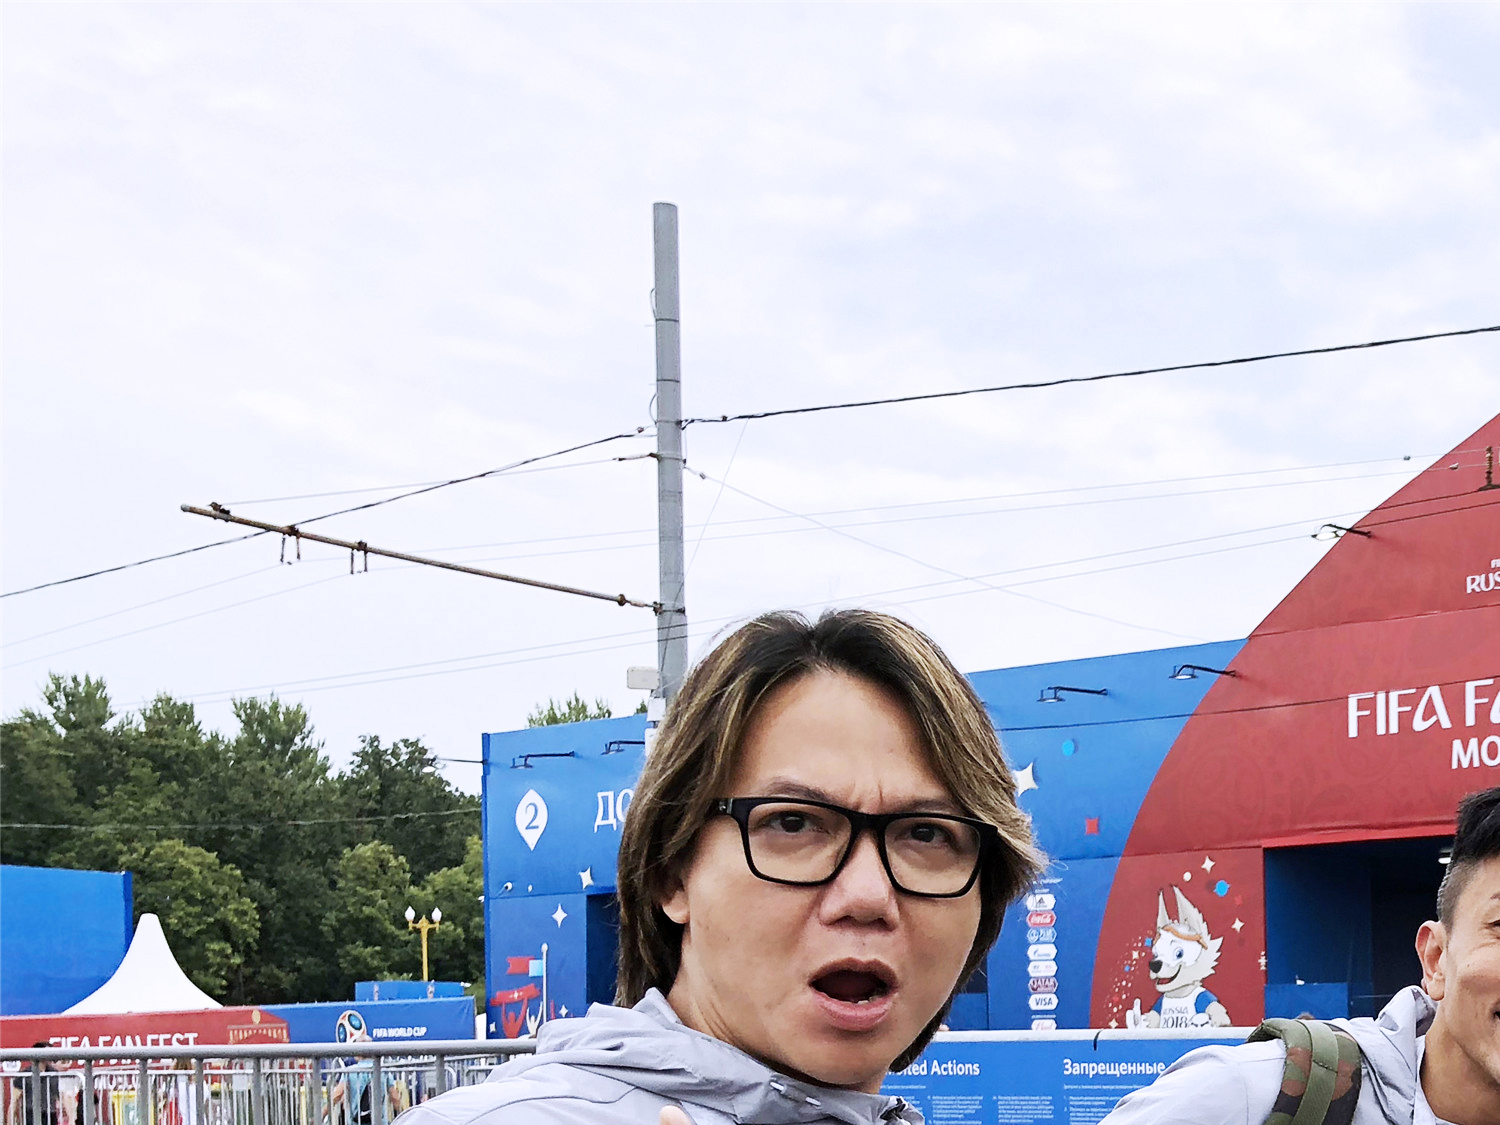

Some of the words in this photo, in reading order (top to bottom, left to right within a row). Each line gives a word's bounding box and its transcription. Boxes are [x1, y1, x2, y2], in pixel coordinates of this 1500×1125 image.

[1347, 685, 1452, 738] FIFA
[525, 802, 539, 830] 2
[1035, 998, 1053, 1006] VISA
[373, 1028, 387, 1038] FIFA
[387, 1026, 412, 1038] WORLD
[413, 1025, 427, 1037] CUP
[931, 1059, 980, 1076] Actions
[1063, 1058, 1166, 1078] Запрещенные
